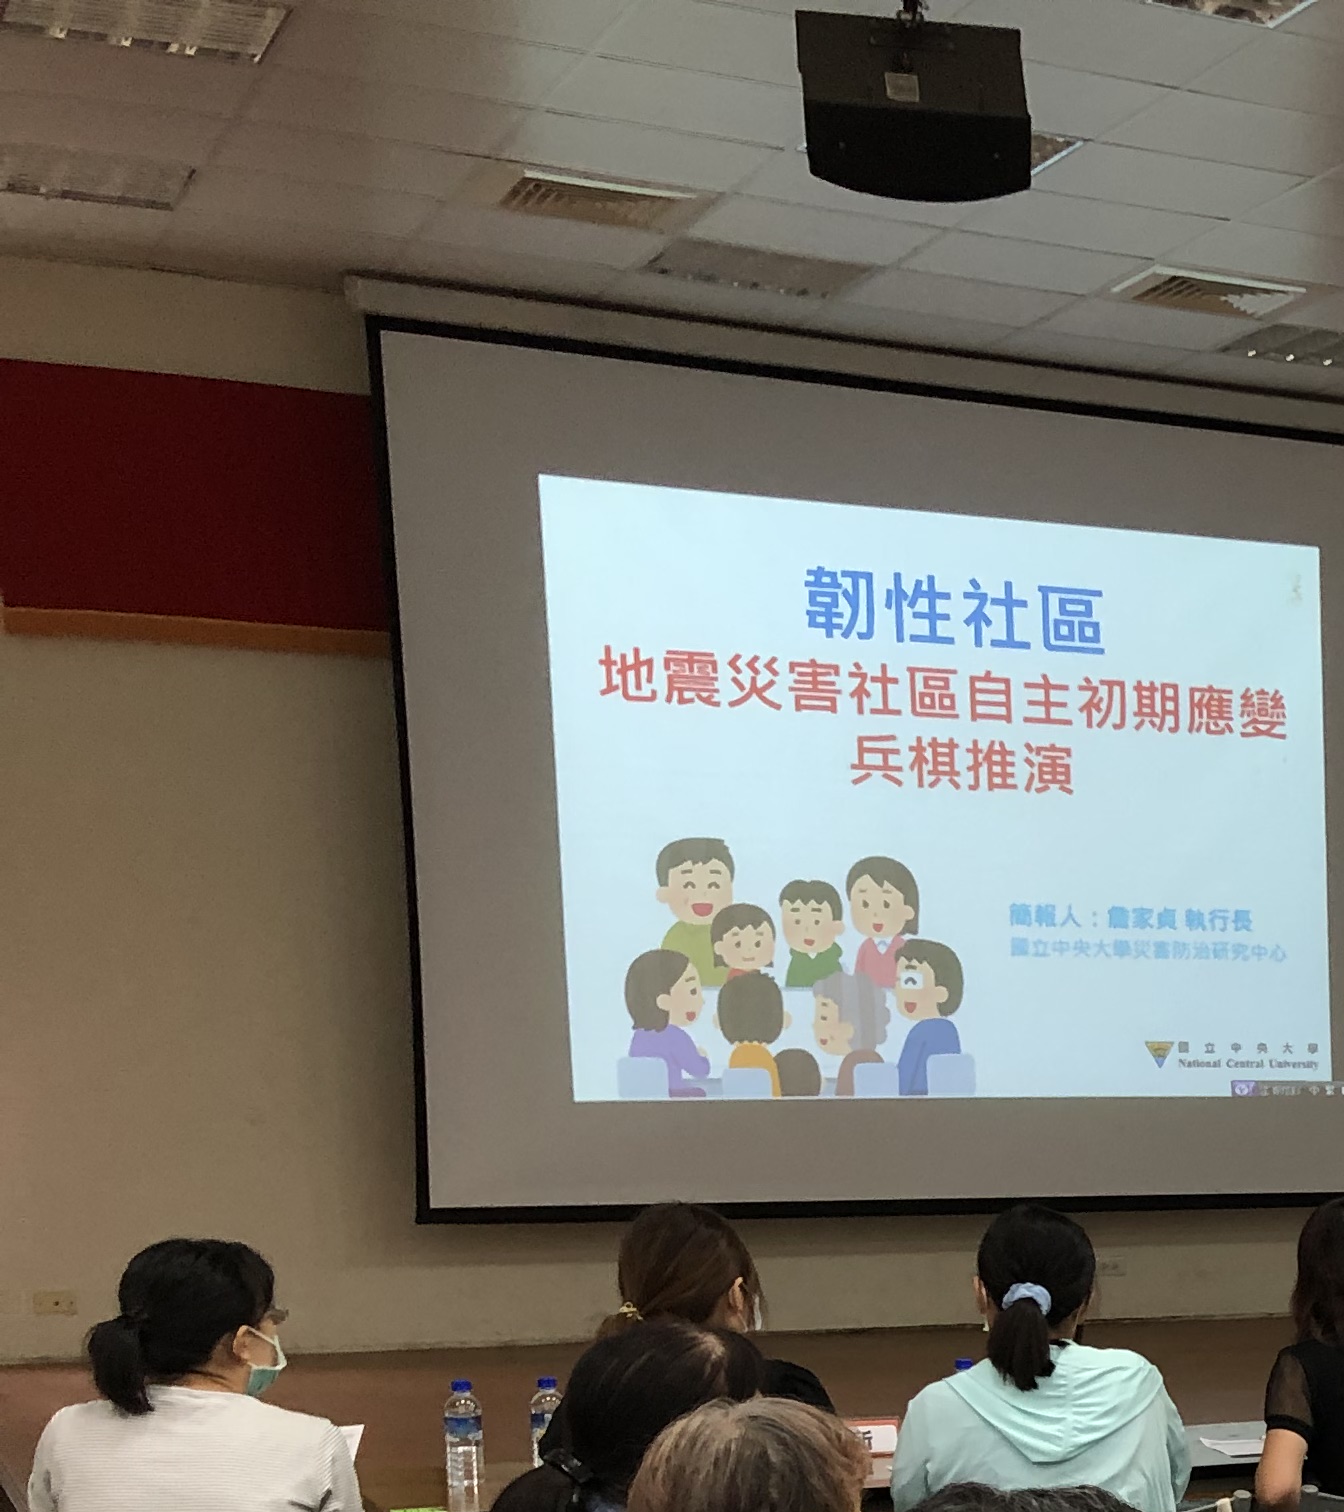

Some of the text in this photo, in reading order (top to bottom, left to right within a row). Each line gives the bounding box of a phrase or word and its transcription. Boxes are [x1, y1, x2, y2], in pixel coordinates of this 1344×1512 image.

[804, 566, 1105, 655] 韌性社區
[598, 645, 1288, 741] 地震災害社區自主初期應變
[849, 733, 1075, 796] 兵棋推演
[1185, 907, 1254, 932] 執行長
[1010, 936, 1287, 963] 國立中央大學災害防治研究中心
[1178, 1041, 1319, 1055] 國立中央大學
[1178, 1058, 1320, 1071] National Central University
